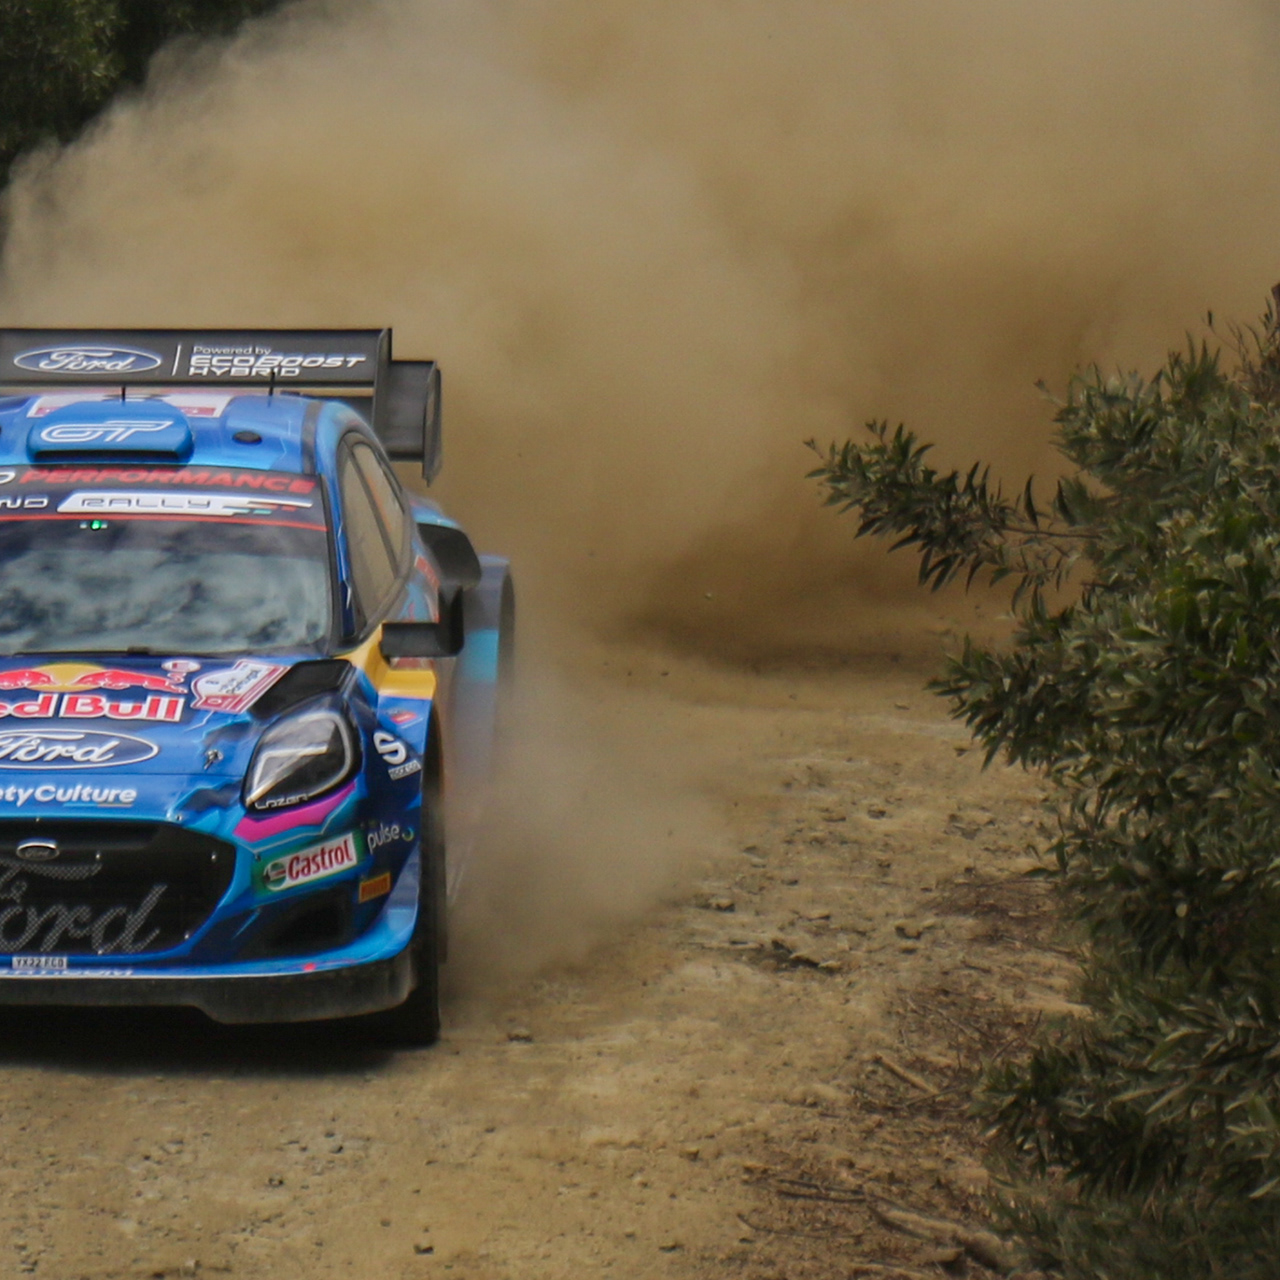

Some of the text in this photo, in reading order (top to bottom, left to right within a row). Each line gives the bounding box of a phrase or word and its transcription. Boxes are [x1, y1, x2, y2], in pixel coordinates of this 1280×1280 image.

[39, 350, 137, 371] Ford
[193, 346, 271, 356] Powered by
[189, 367, 300, 377] HYBRID
[19, 469, 316, 494] PERFORMANCE
[81, 498, 212, 509] RALLY
[59, 693, 185, 723] Bull
[367, 823, 400, 854] pulse
[287, 838, 353, 881] Castrol
